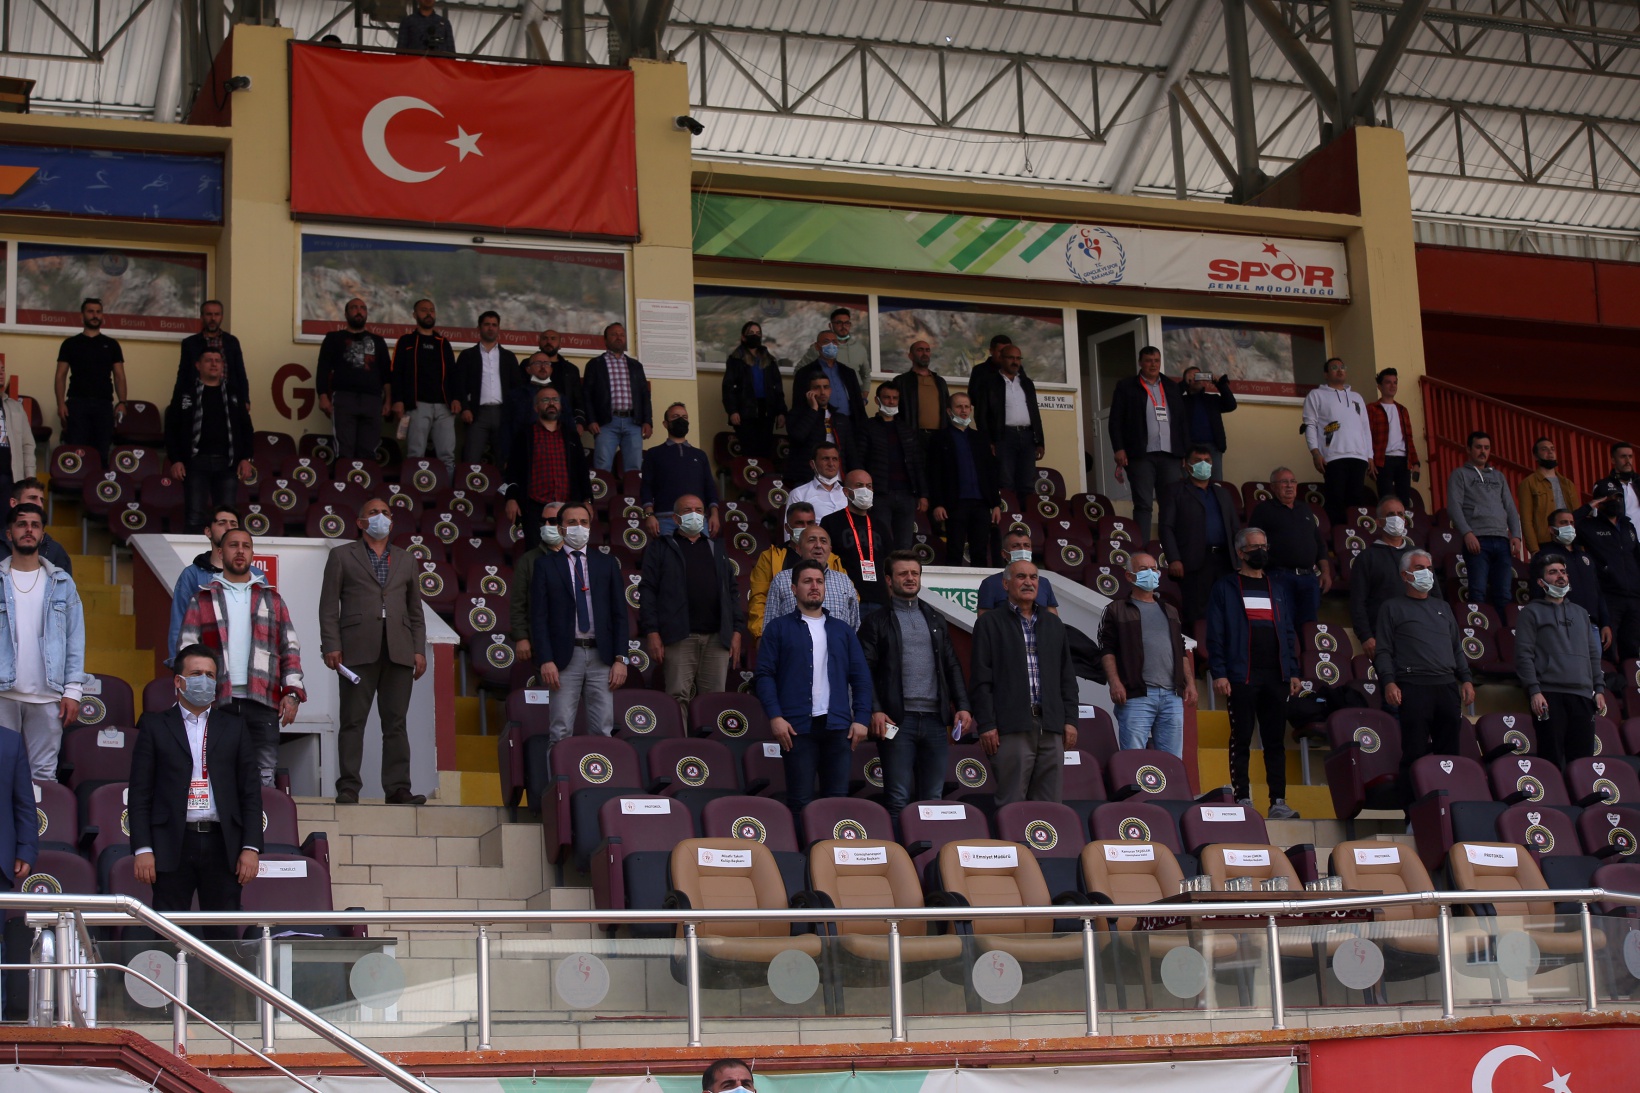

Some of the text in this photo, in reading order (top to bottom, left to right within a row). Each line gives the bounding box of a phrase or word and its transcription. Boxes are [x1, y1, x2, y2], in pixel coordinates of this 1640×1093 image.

[1207, 258, 1334, 287] SPOR
[1208, 282, 1334, 296] GENEL MÜDÜRLÜĞÜ
[40, 314, 66, 324] Basın
[120, 318, 146, 328] Basın
[160, 320, 185, 329] Basın
[370, 326, 394, 335] Yayın
[438, 329, 462, 338] Yayın
[503, 332, 527, 342] Yayın
[568, 336, 592, 345] Yayın
[1236, 383, 1270, 392] Ses Yayın
